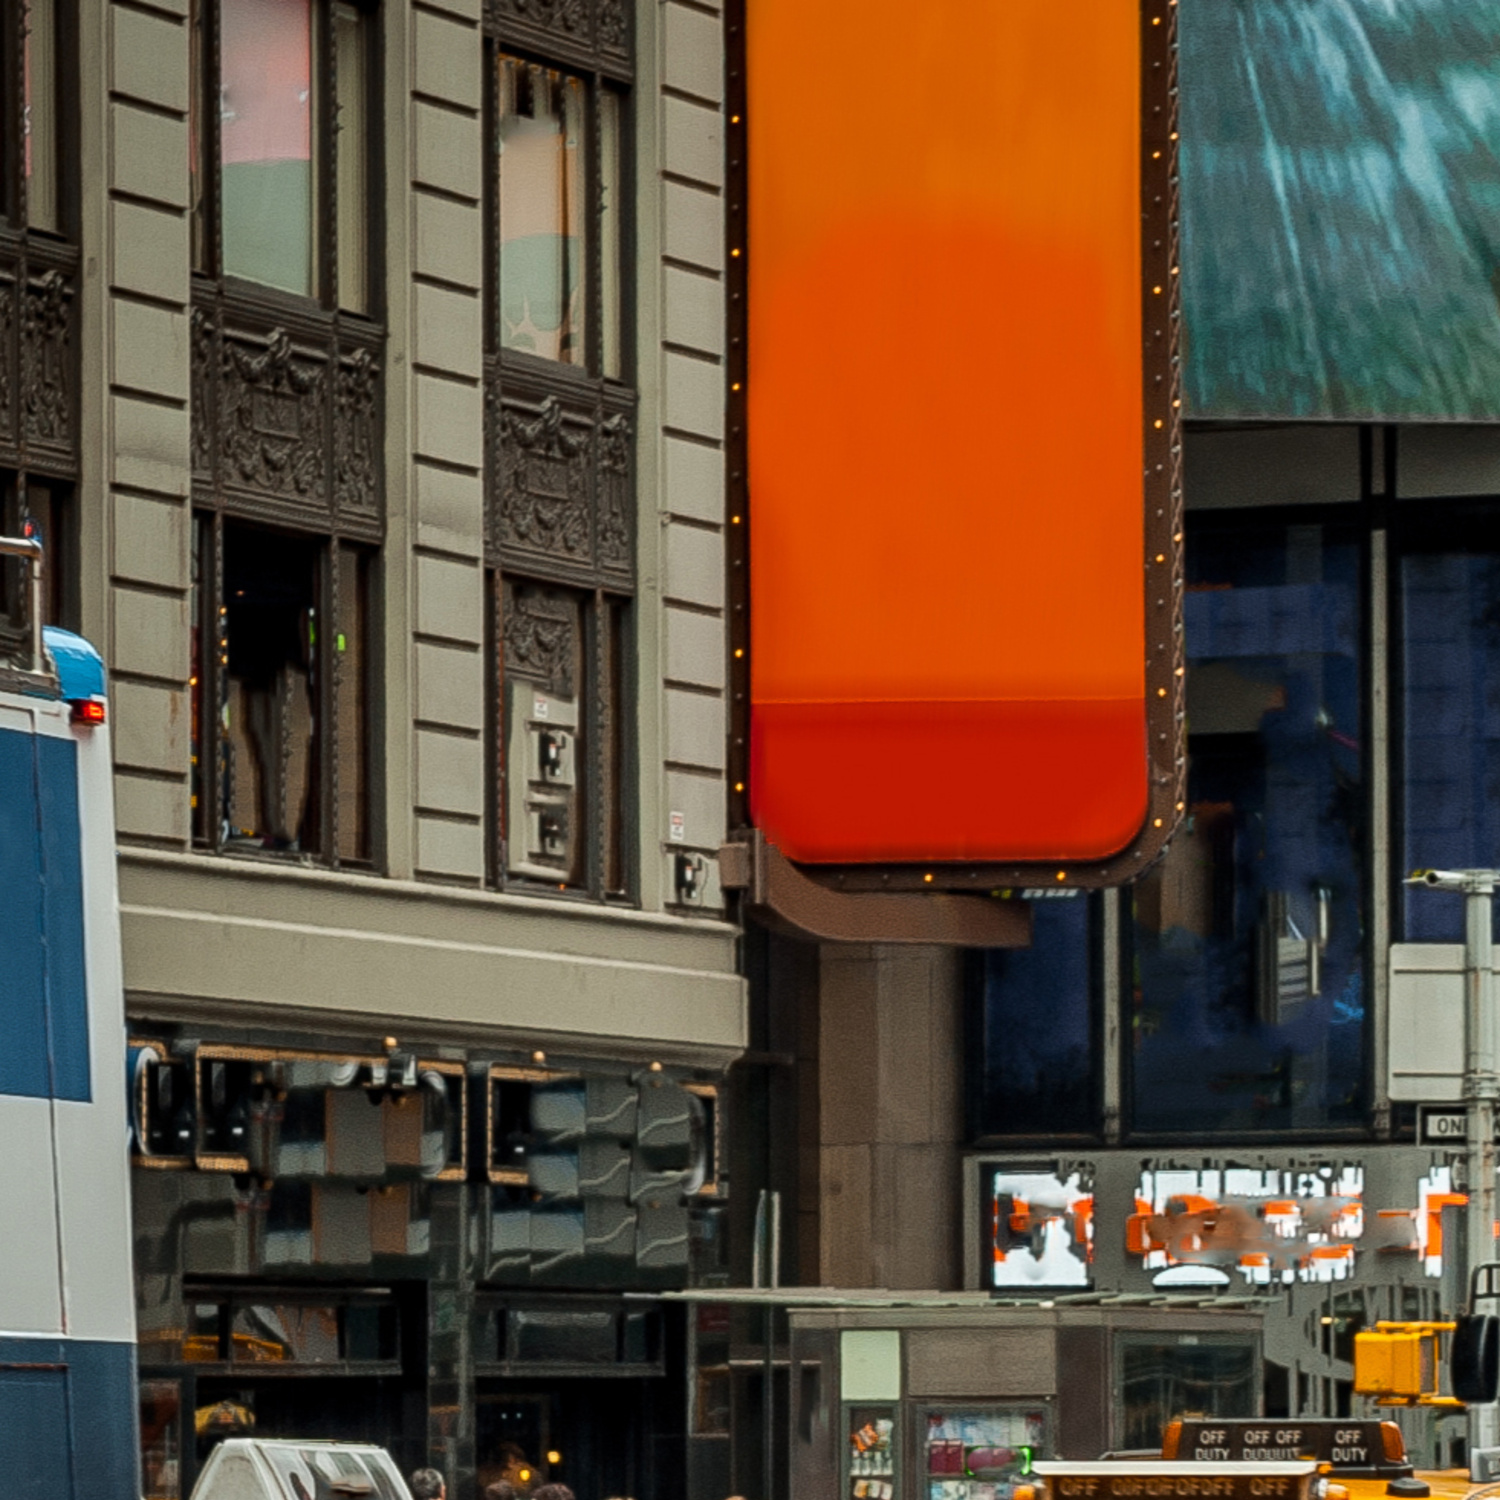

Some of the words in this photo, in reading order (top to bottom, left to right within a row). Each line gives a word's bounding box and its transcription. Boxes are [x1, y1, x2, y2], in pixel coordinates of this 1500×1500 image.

[1200, 1430, 1226, 1444] OFF
[1244, 1430, 1270, 1444] OFF
[1275, 1430, 1302, 1444] OFF
[1335, 1430, 1361, 1444] OFF
[1195, 1448, 1230, 1461] DUTY
[1332, 1448, 1367, 1461] DUTY
